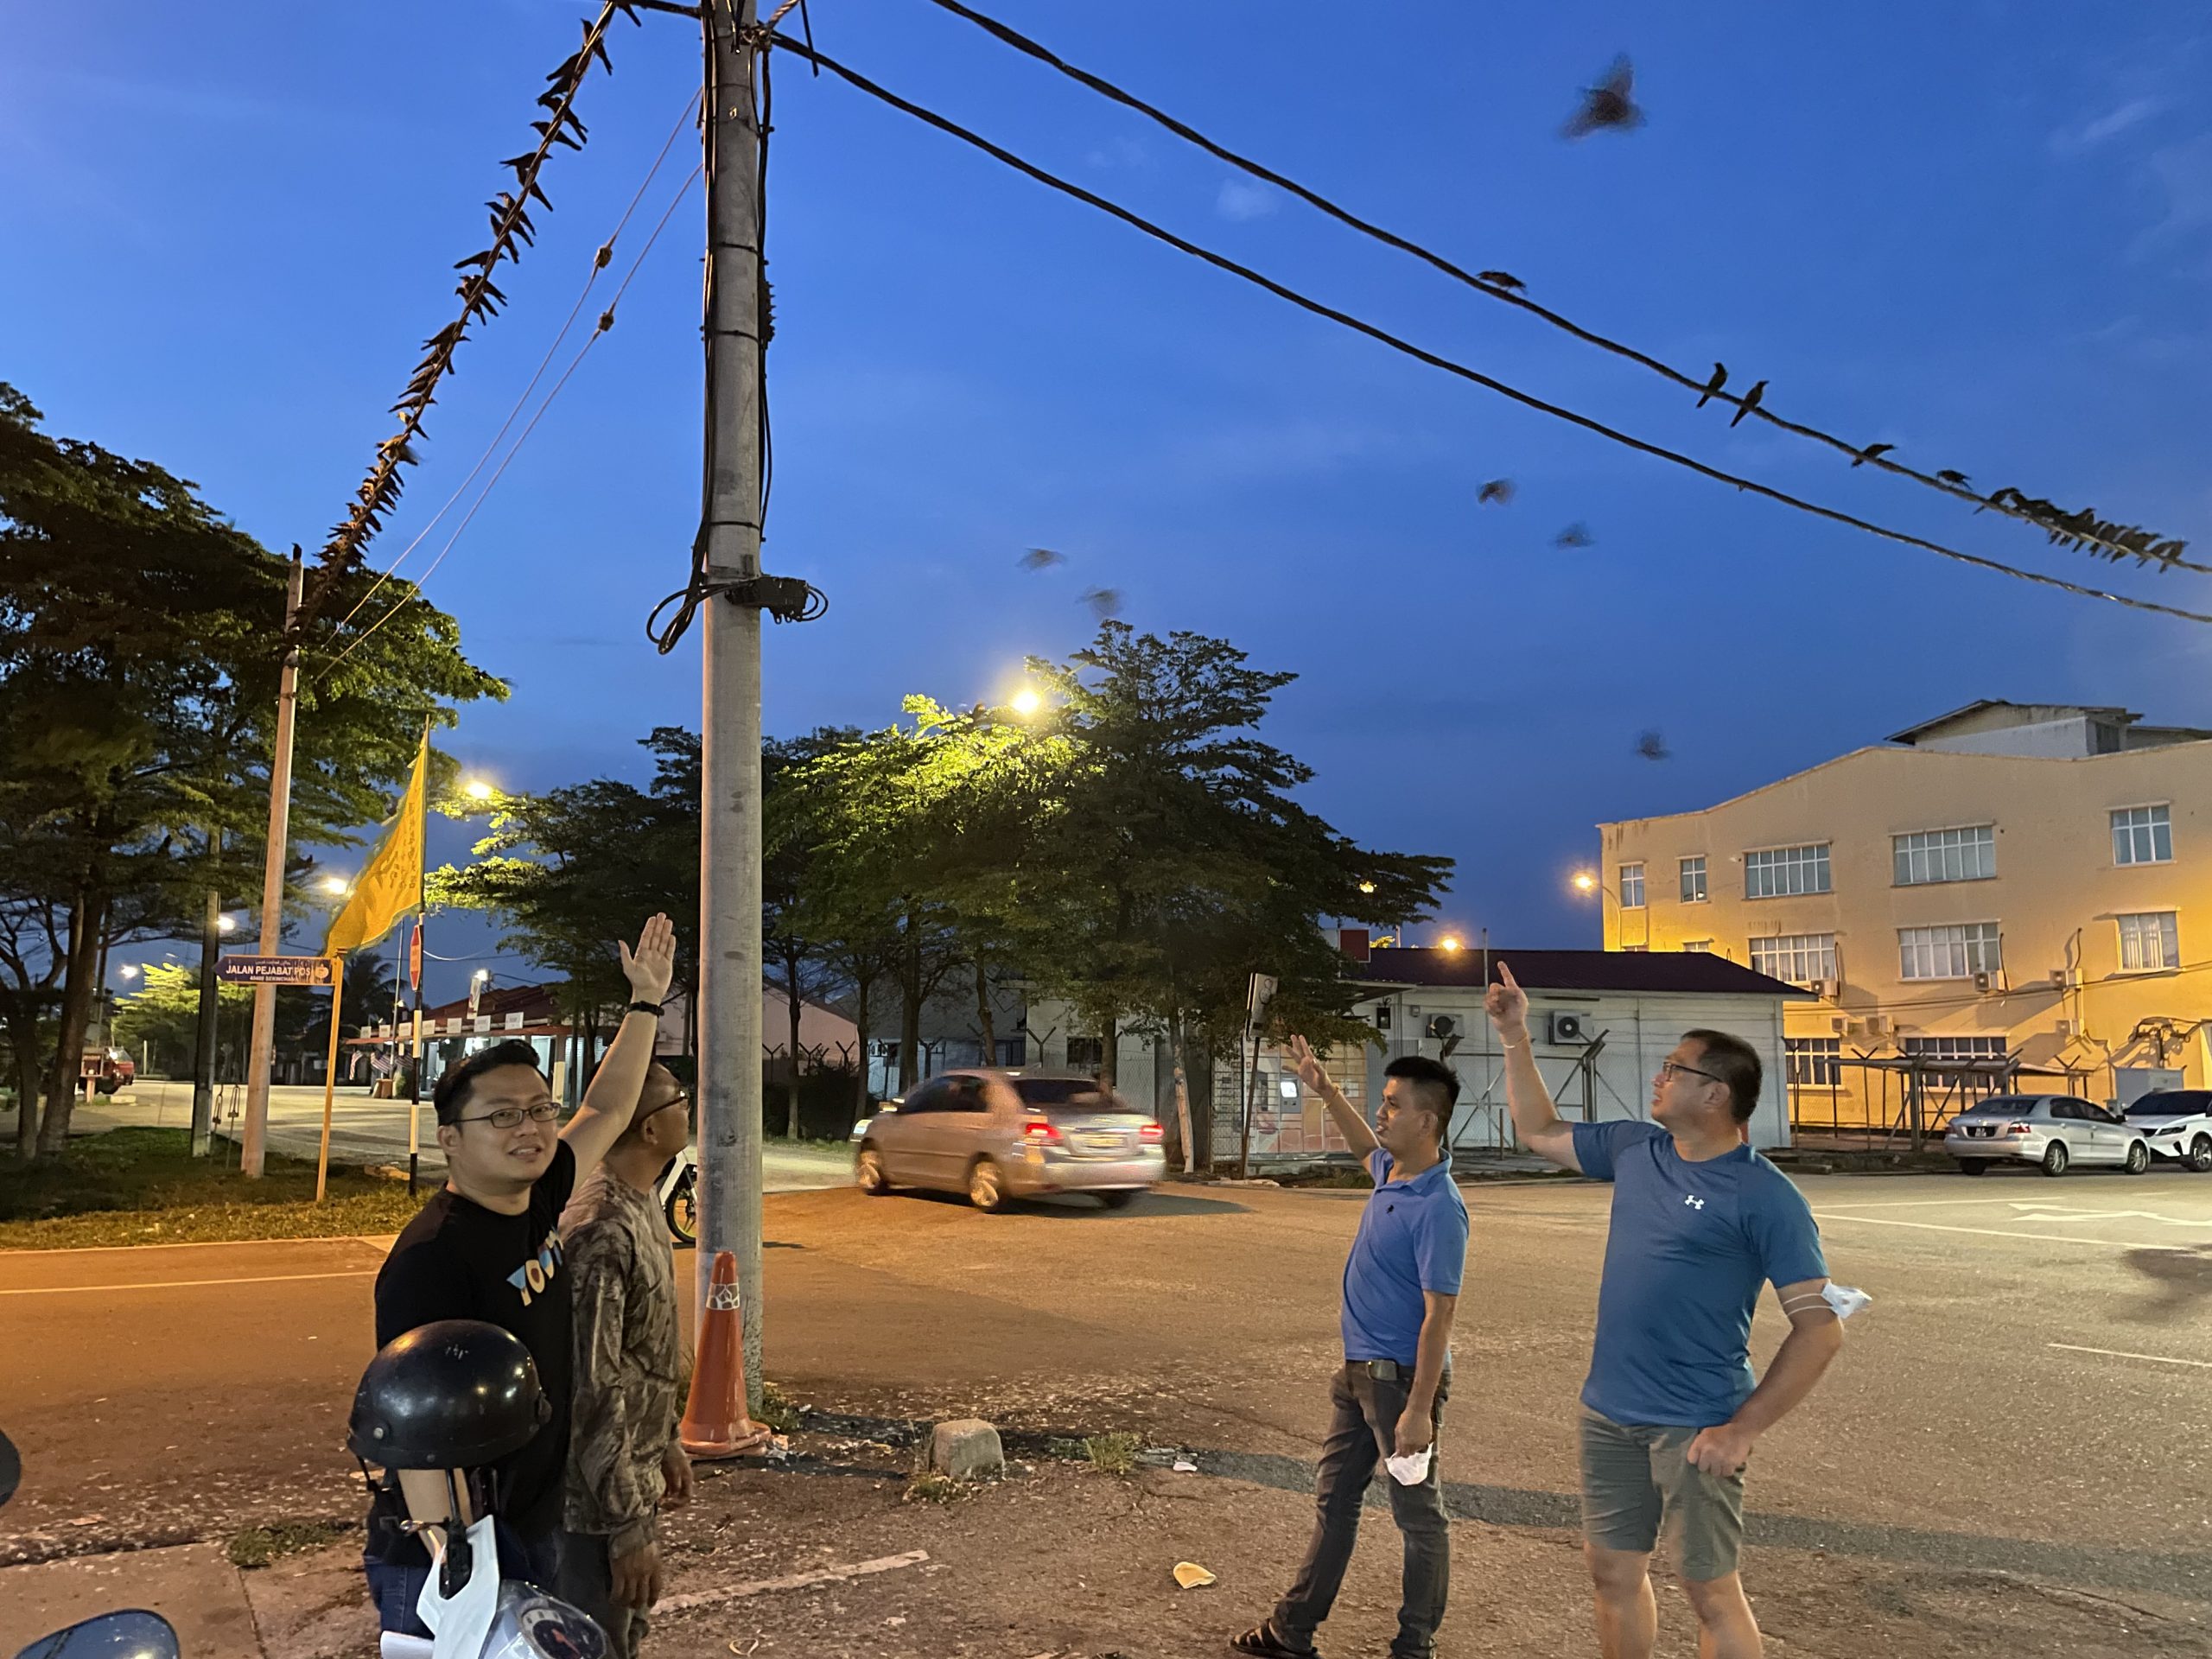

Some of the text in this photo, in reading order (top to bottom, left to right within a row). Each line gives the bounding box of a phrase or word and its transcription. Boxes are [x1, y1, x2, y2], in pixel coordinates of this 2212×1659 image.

[226, 965, 310, 976] JALAN PEJABAT POS
